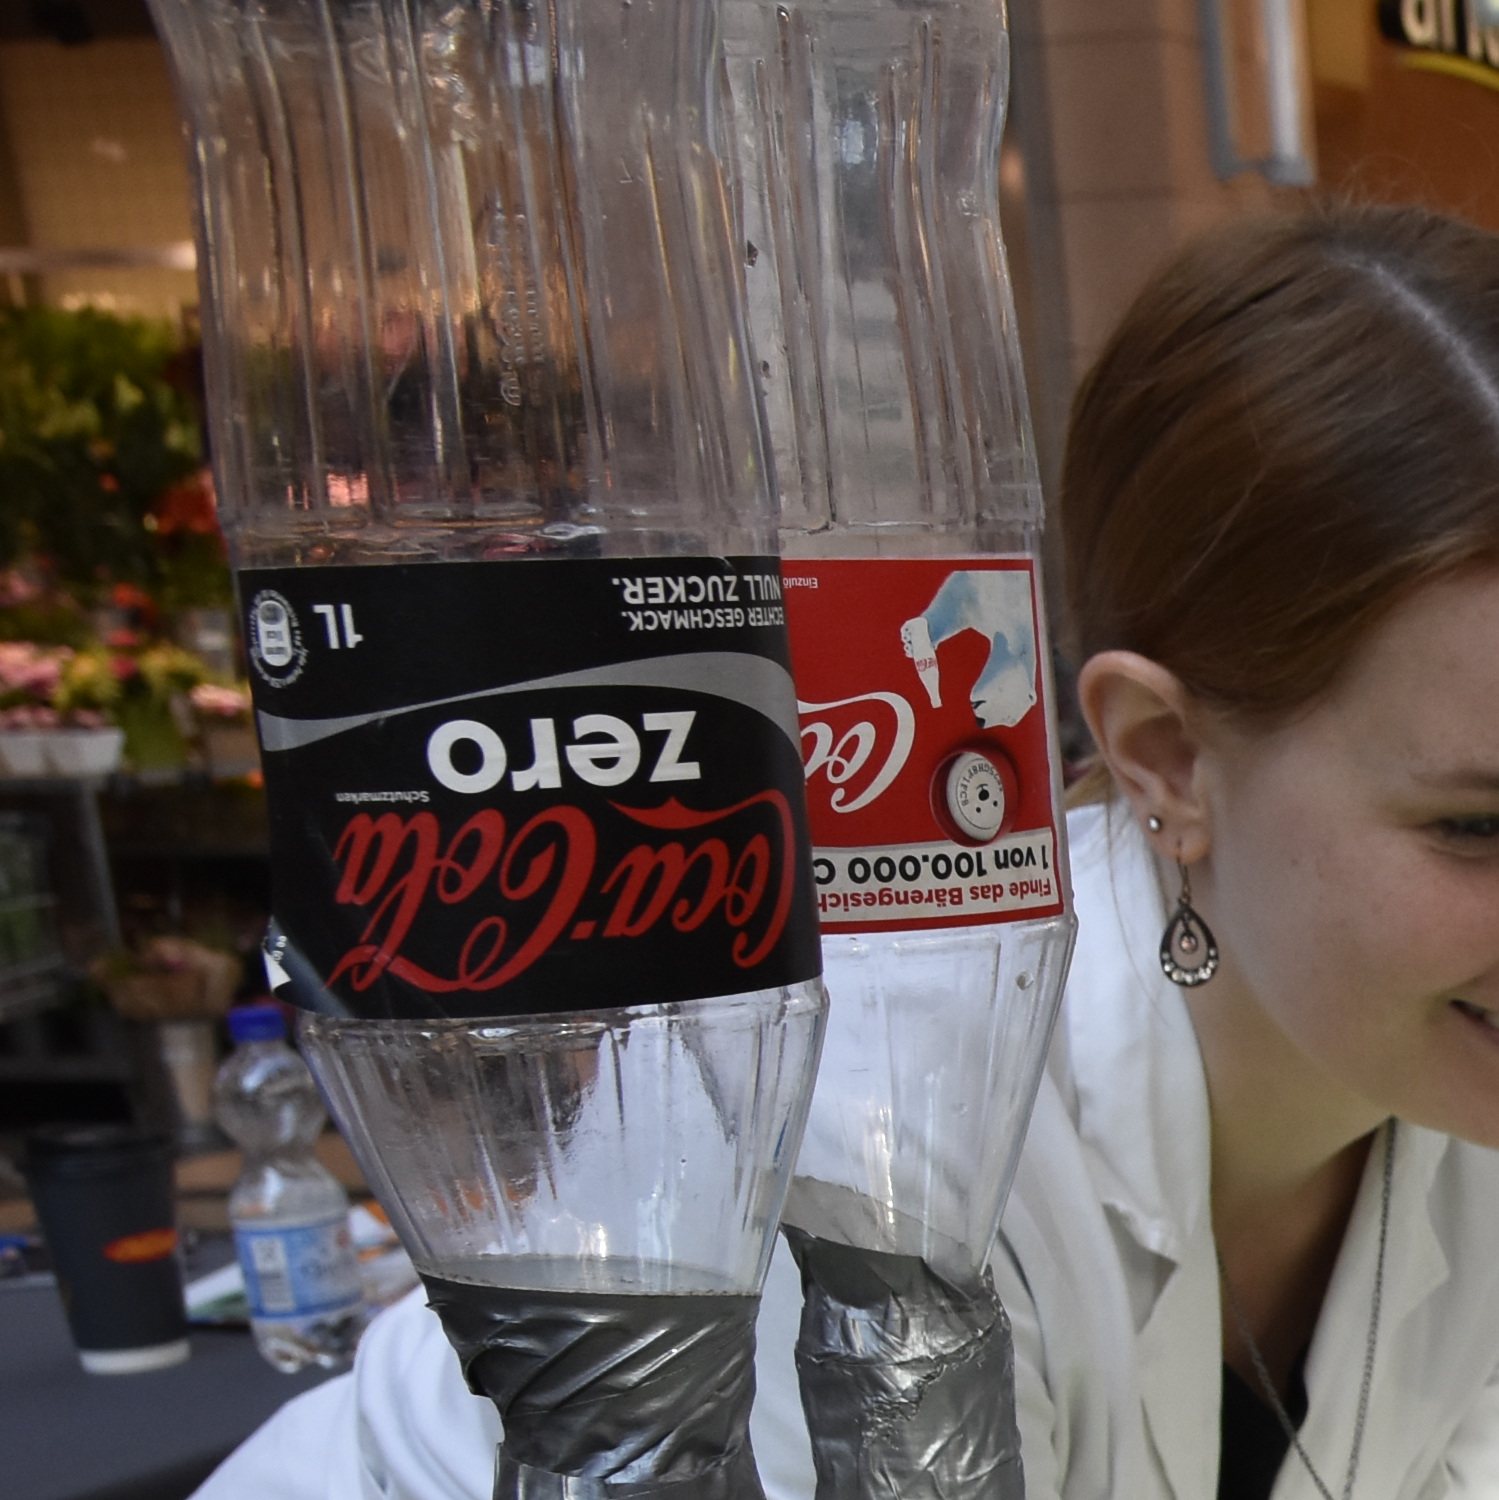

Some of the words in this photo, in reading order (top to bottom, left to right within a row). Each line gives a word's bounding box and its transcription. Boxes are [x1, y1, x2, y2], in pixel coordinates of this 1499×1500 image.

[612, 576, 738, 605] ZUCKER.
[744, 575, 781, 601] NULL
[313, 604, 364, 650] 1L
[621, 607, 746, 632] GESCHMACK.
[748, 605, 785, 626] ECHTER
[426, 710, 702, 795] zero
[335, 789, 431, 805] Schutzmarken
[847, 851, 988, 885] 100.000
[994, 846, 1037, 871] von
[1040, 844, 1049, 871] 1
[323, 789, 798, 992] Coca-Cola
[969, 883, 1004, 904] das
[1009, 876, 1052, 900] Finde
